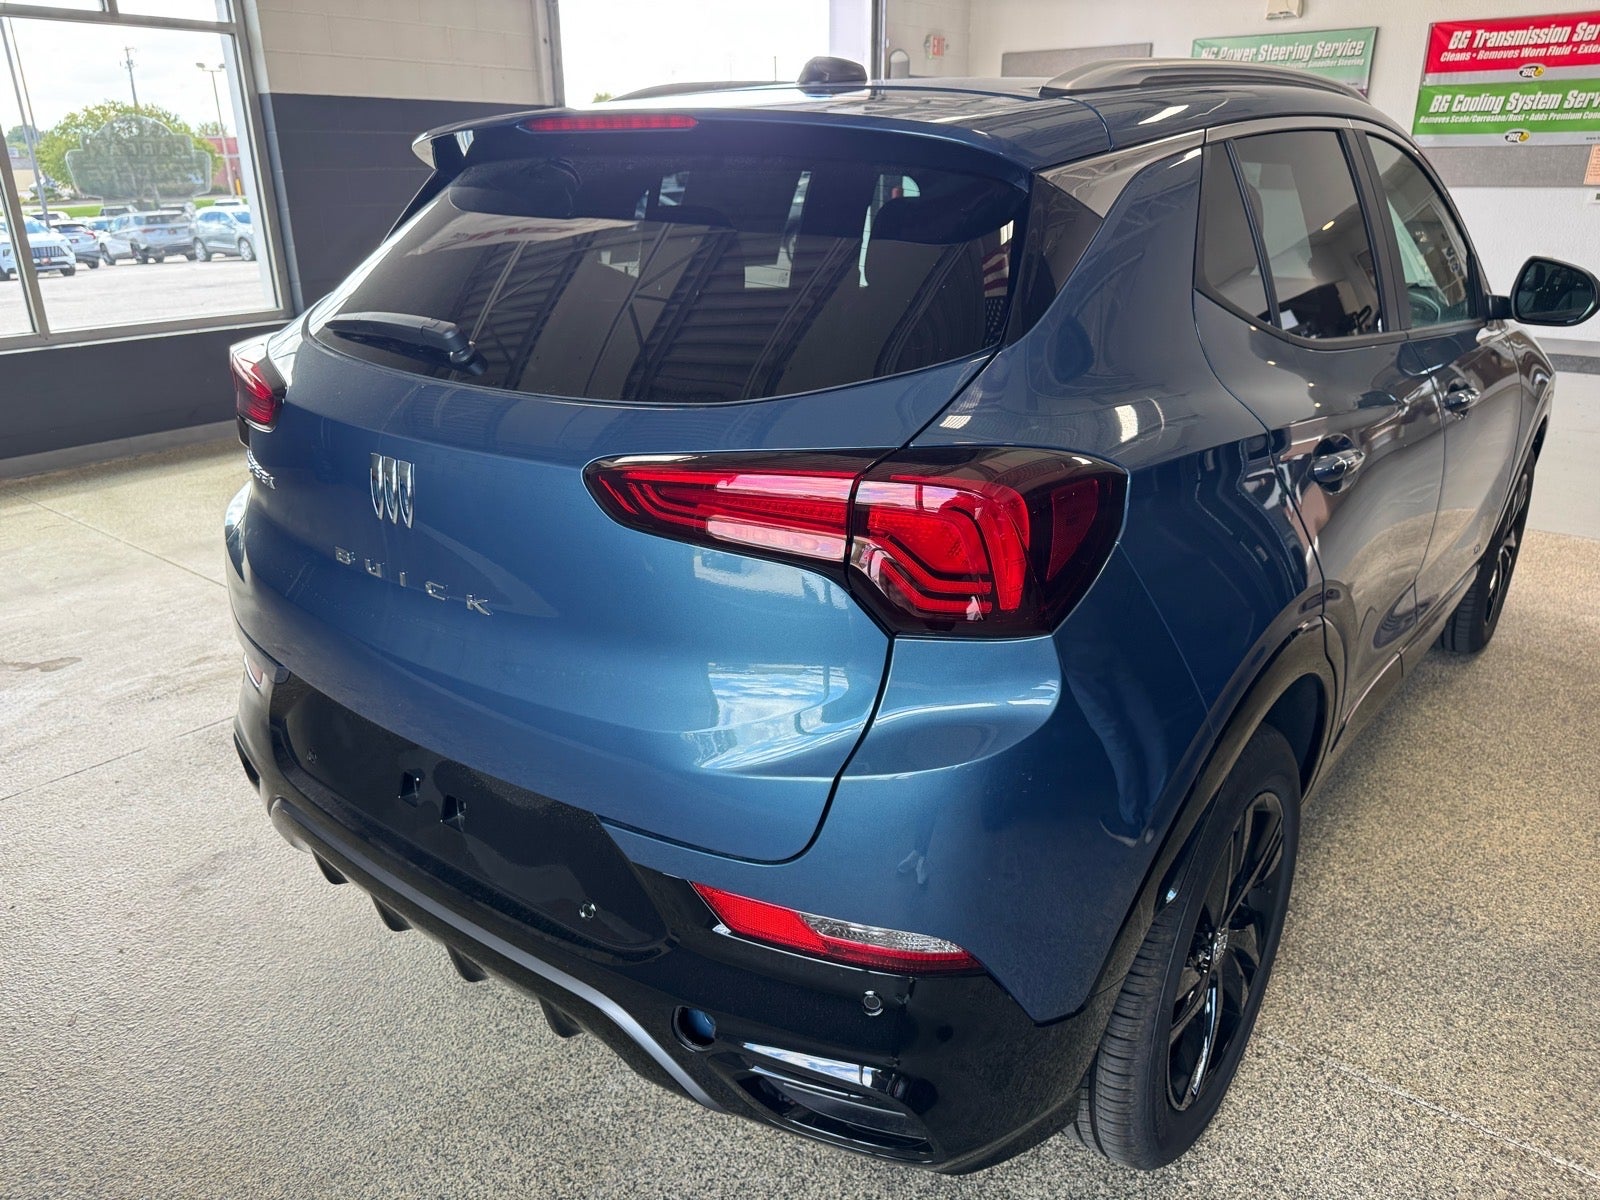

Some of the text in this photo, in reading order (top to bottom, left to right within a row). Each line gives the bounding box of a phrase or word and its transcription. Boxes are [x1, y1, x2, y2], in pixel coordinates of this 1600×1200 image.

[1448, 30, 1472, 49] BG
[1472, 25, 1573, 48] Transmission
[1219, 46, 1257, 62] Power
[1258, 43, 1314, 62] Steering
[1314, 38, 1366, 58] Service
[1440, 51, 1471, 62] Cleans
[1477, 49, 1519, 60] Removes
[1520, 47, 1546, 58] Worn
[1546, 44, 1571, 56] Fluid
[1429, 94, 1452, 113] BG
[1452, 93, 1505, 114] Cooling
[1505, 91, 1563, 114] System
[1419, 115, 1450, 124] Removes
[1450, 113, 1525, 123] Scale/Corrosion/Rust
[1529, 112, 1549, 122] Adds
[1548, 111, 1583, 121] Premium
[334, 546, 493, 616] BUICK
